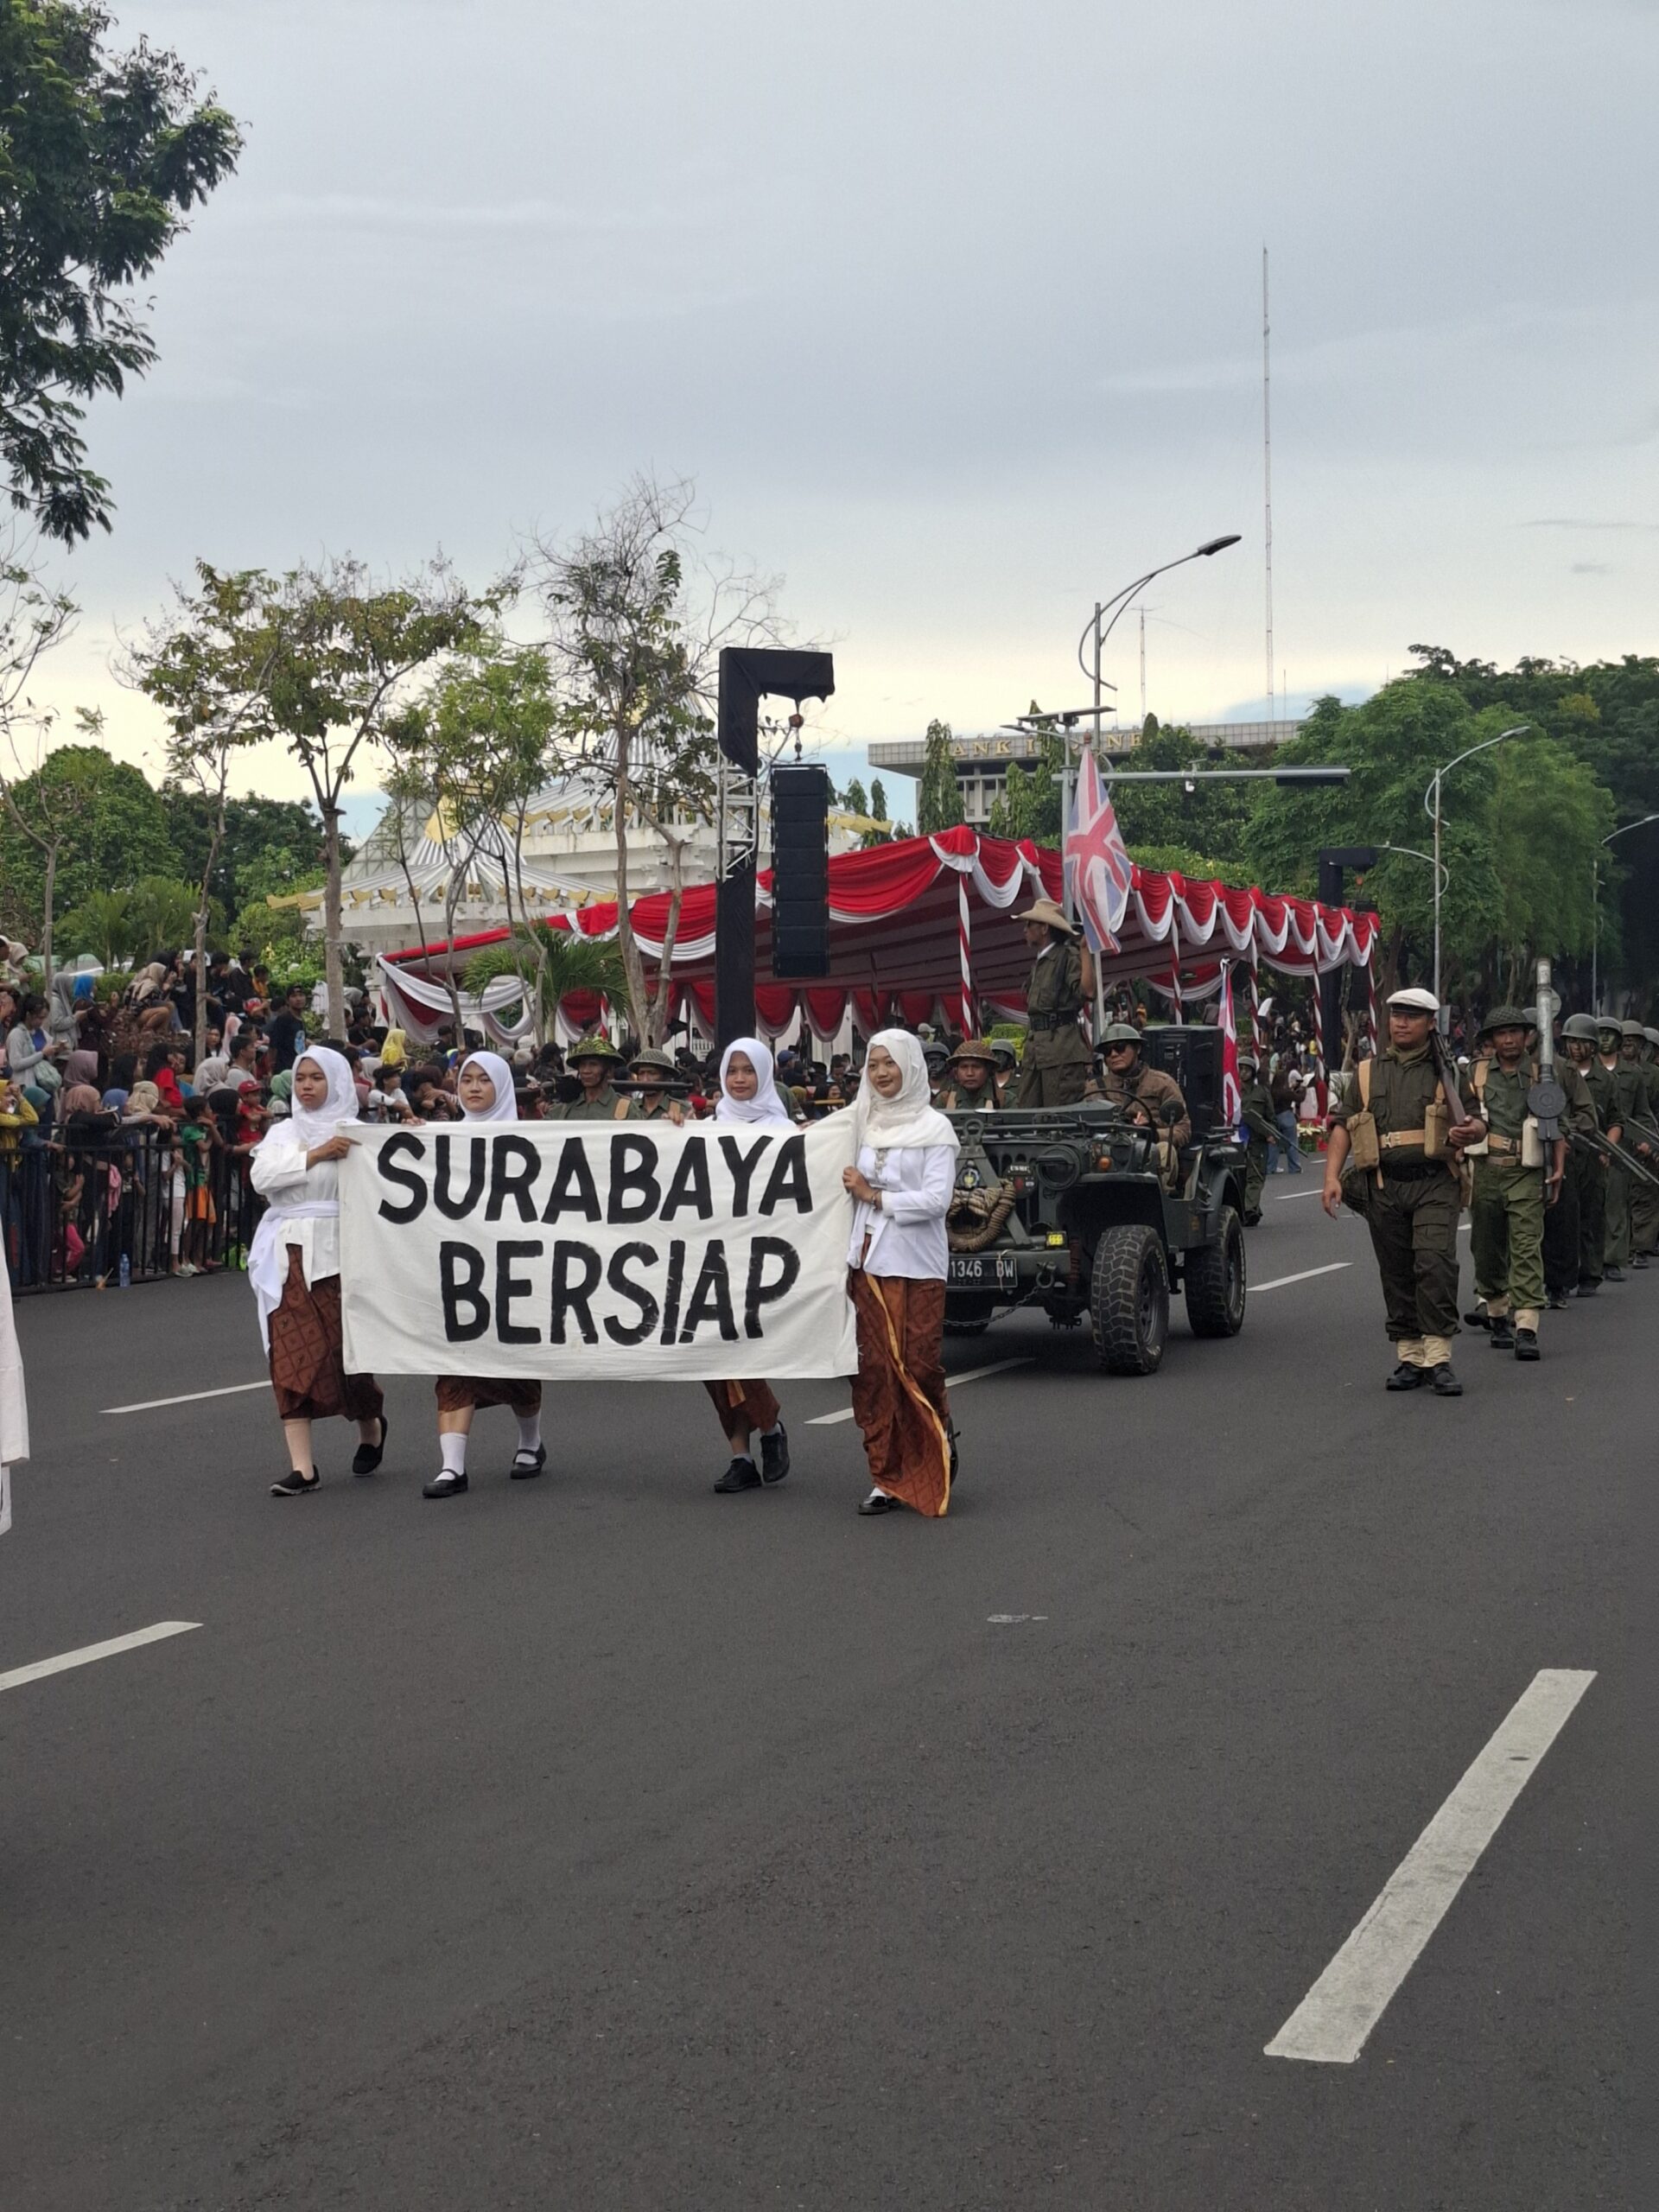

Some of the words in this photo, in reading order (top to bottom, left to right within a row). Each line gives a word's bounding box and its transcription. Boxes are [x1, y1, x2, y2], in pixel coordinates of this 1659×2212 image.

[378, 1132, 813, 1224] SURABAYA
[439, 1236, 800, 1345] BERSIAP
[950, 1260, 982, 1278] 1346
